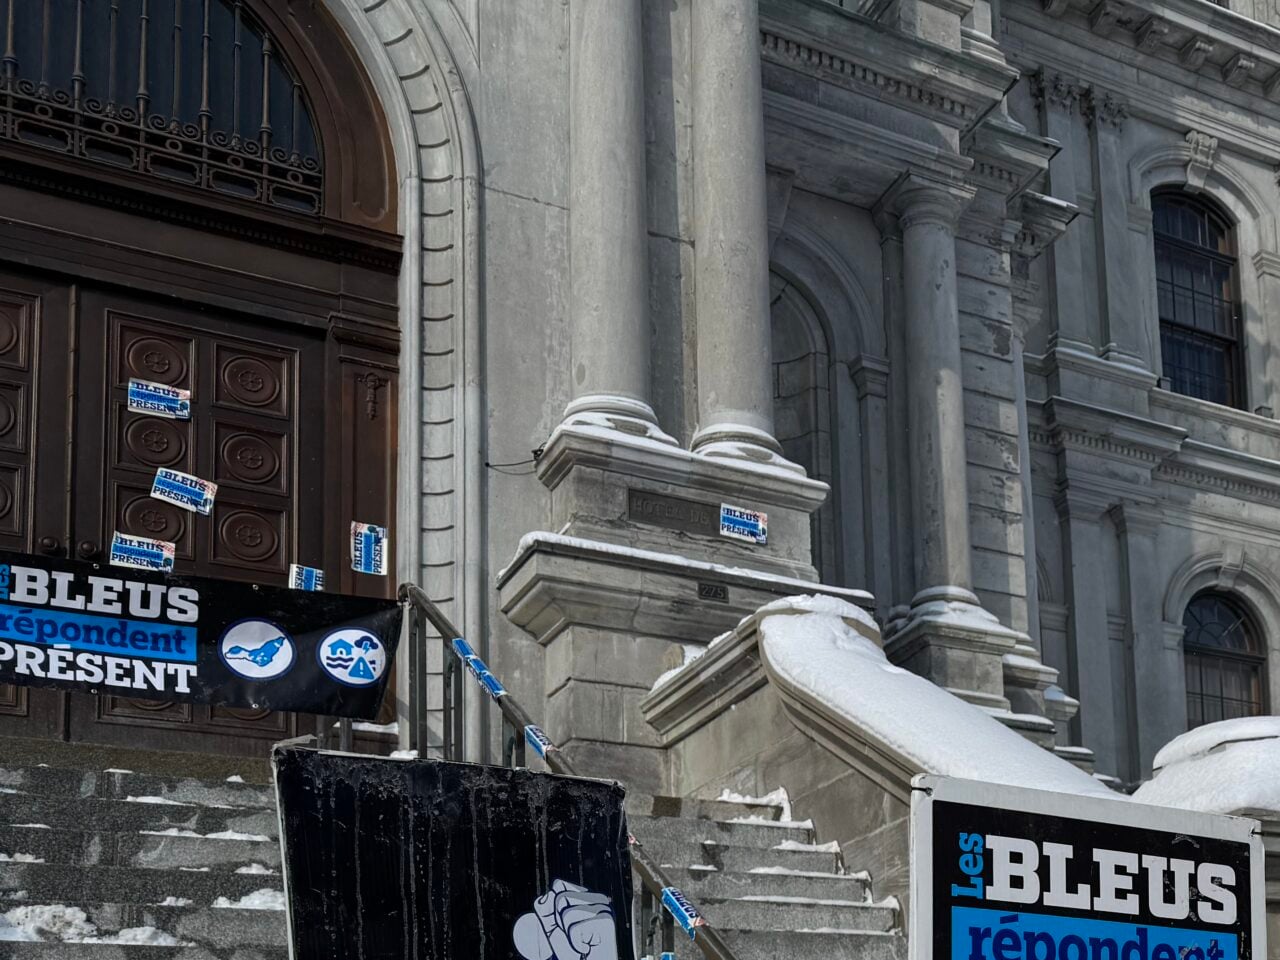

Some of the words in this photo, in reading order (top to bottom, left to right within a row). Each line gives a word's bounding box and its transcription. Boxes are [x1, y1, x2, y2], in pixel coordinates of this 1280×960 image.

[164, 471, 207, 492] BLEUS
[120, 537, 164, 552] BLEUS
[10, 565, 199, 623] BLEUS
[0, 609, 187, 654] répondent
[951, 832, 984, 899] Les
[985, 834, 1238, 925] BLEUS
